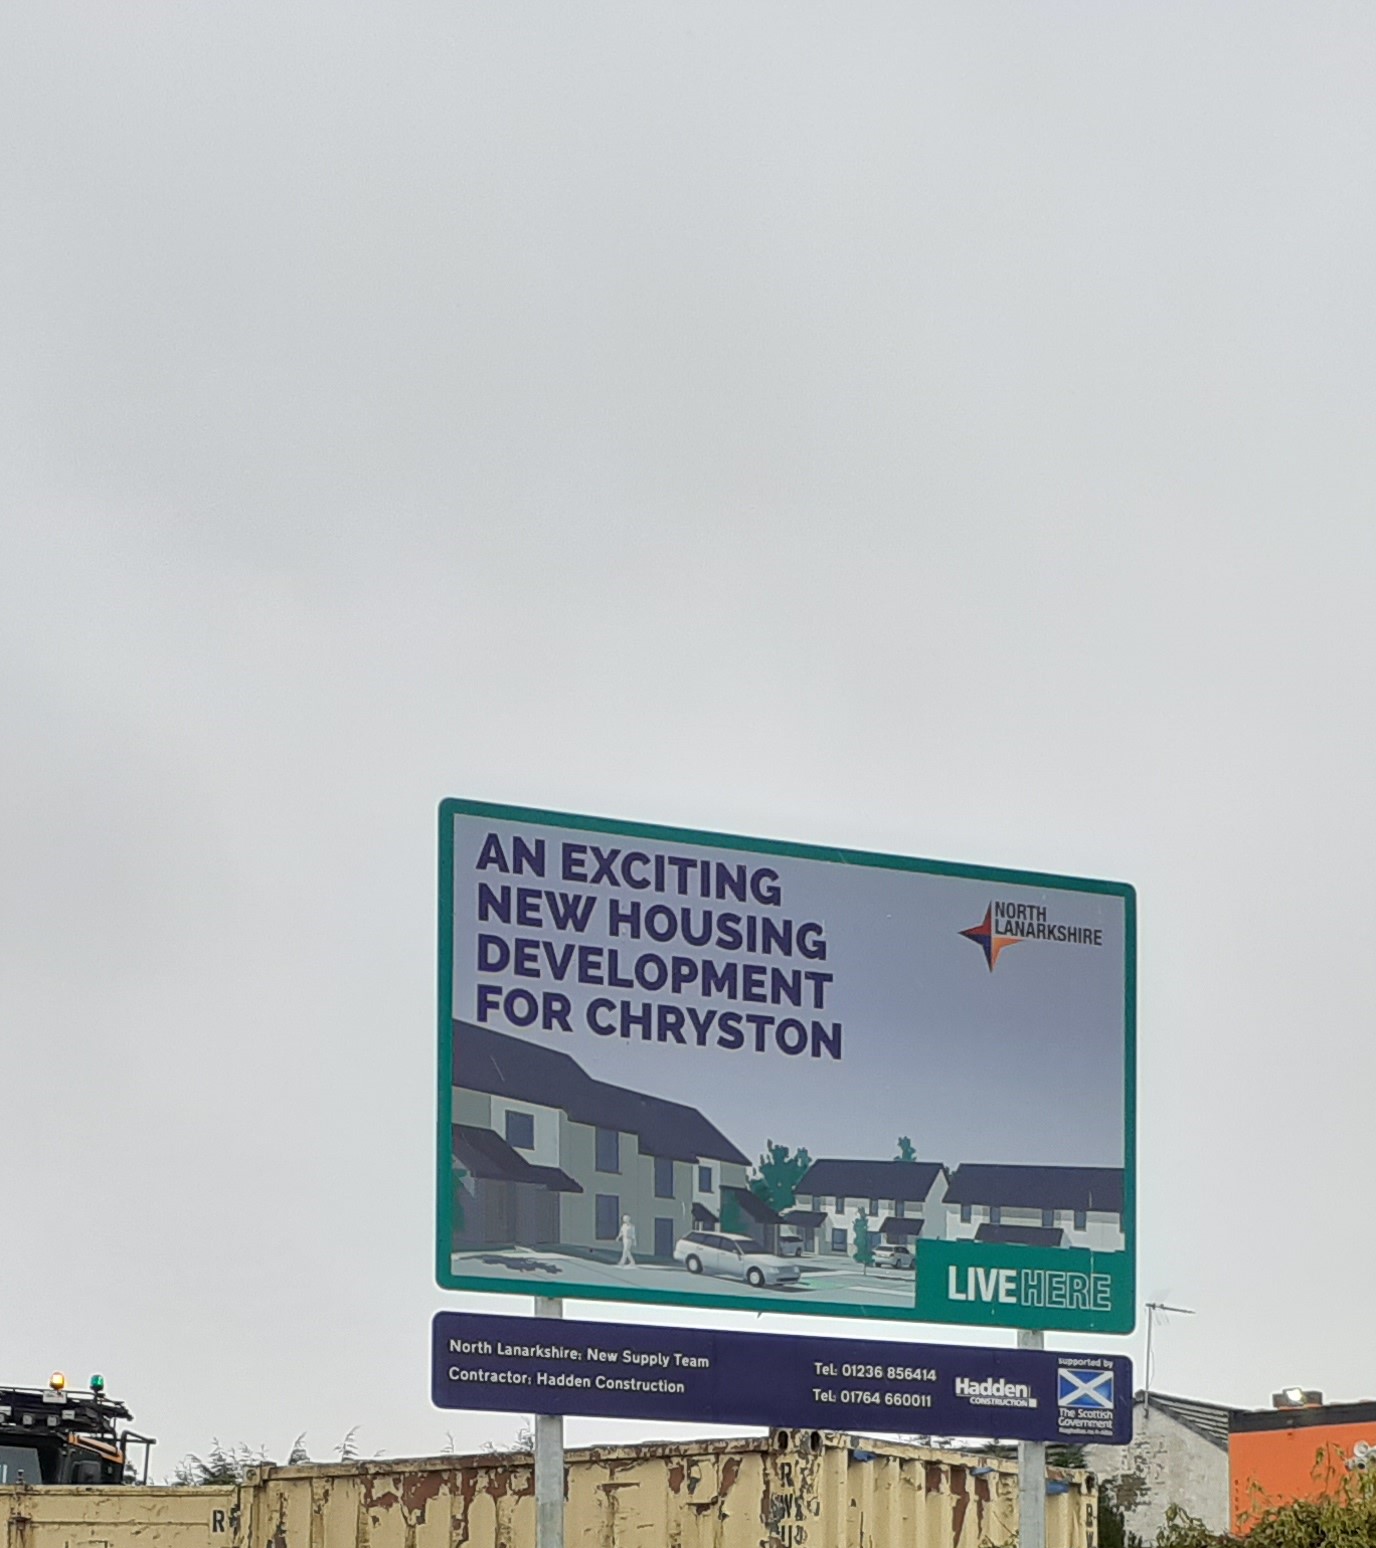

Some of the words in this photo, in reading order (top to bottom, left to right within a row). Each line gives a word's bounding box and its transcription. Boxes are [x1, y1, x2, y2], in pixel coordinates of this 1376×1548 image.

[476, 832, 546, 878] AN
[561, 842, 782, 907] EXCITING
[478, 882, 597, 933] NEW
[608, 898, 827, 961] HOUSING
[995, 901, 1047, 922] NORTH
[995, 918, 1103, 946] LANARKSHIRE
[477, 934, 834, 1009] DEVELOPMENT
[476, 984, 574, 1032] FOR
[586, 997, 842, 1060] CHRYSTON
[948, 1265, 1017, 1304] LIVE
[1021, 1268, 1112, 1311] HERE
[449, 1339, 492, 1355] North
[497, 1342, 582, 1361] Lanarkshire:
[587, 1348, 618, 1363] New
[622, 1350, 669, 1368] Supply
[674, 1353, 709, 1368] Team
[448, 1366, 532, 1385] Contractor:
[536, 1372, 591, 1389] Hadden
[595, 1375, 686, 1394] Construction
[842, 1364, 883, 1378] 01236
[887, 1366, 937, 1381] 856414
[840, 1390, 881, 1404] 01764
[884, 1392, 932, 1407] 660011
[955, 1376, 1028, 1398] Hadden
[969, 1397, 1028, 1408] CONSTRUCTION
[1059, 1407, 1076, 1418] The
[1077, 1409, 1113, 1419] Scottish
[1058, 1416, 1113, 1429] Government
